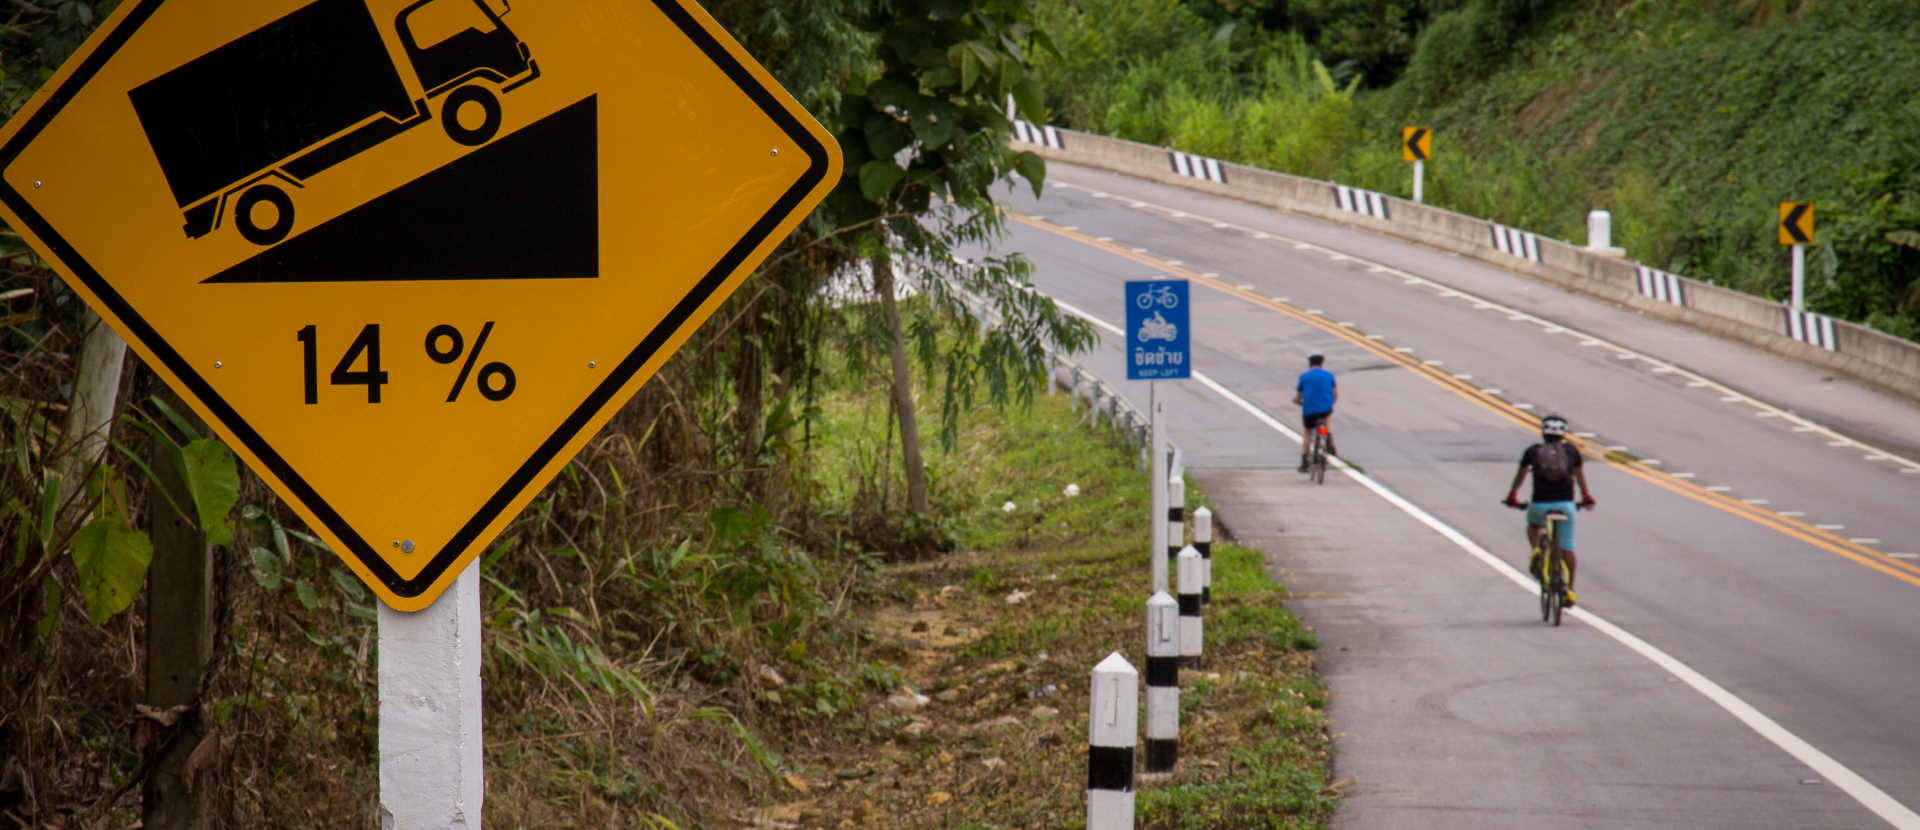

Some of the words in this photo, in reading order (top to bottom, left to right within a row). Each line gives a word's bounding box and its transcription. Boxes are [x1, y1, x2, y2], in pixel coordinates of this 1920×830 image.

[297, 323, 389, 405] 14
[424, 321, 517, 403] %
[1138, 369, 1158, 377] KEEP
[1160, 368, 1179, 376] LEFT
